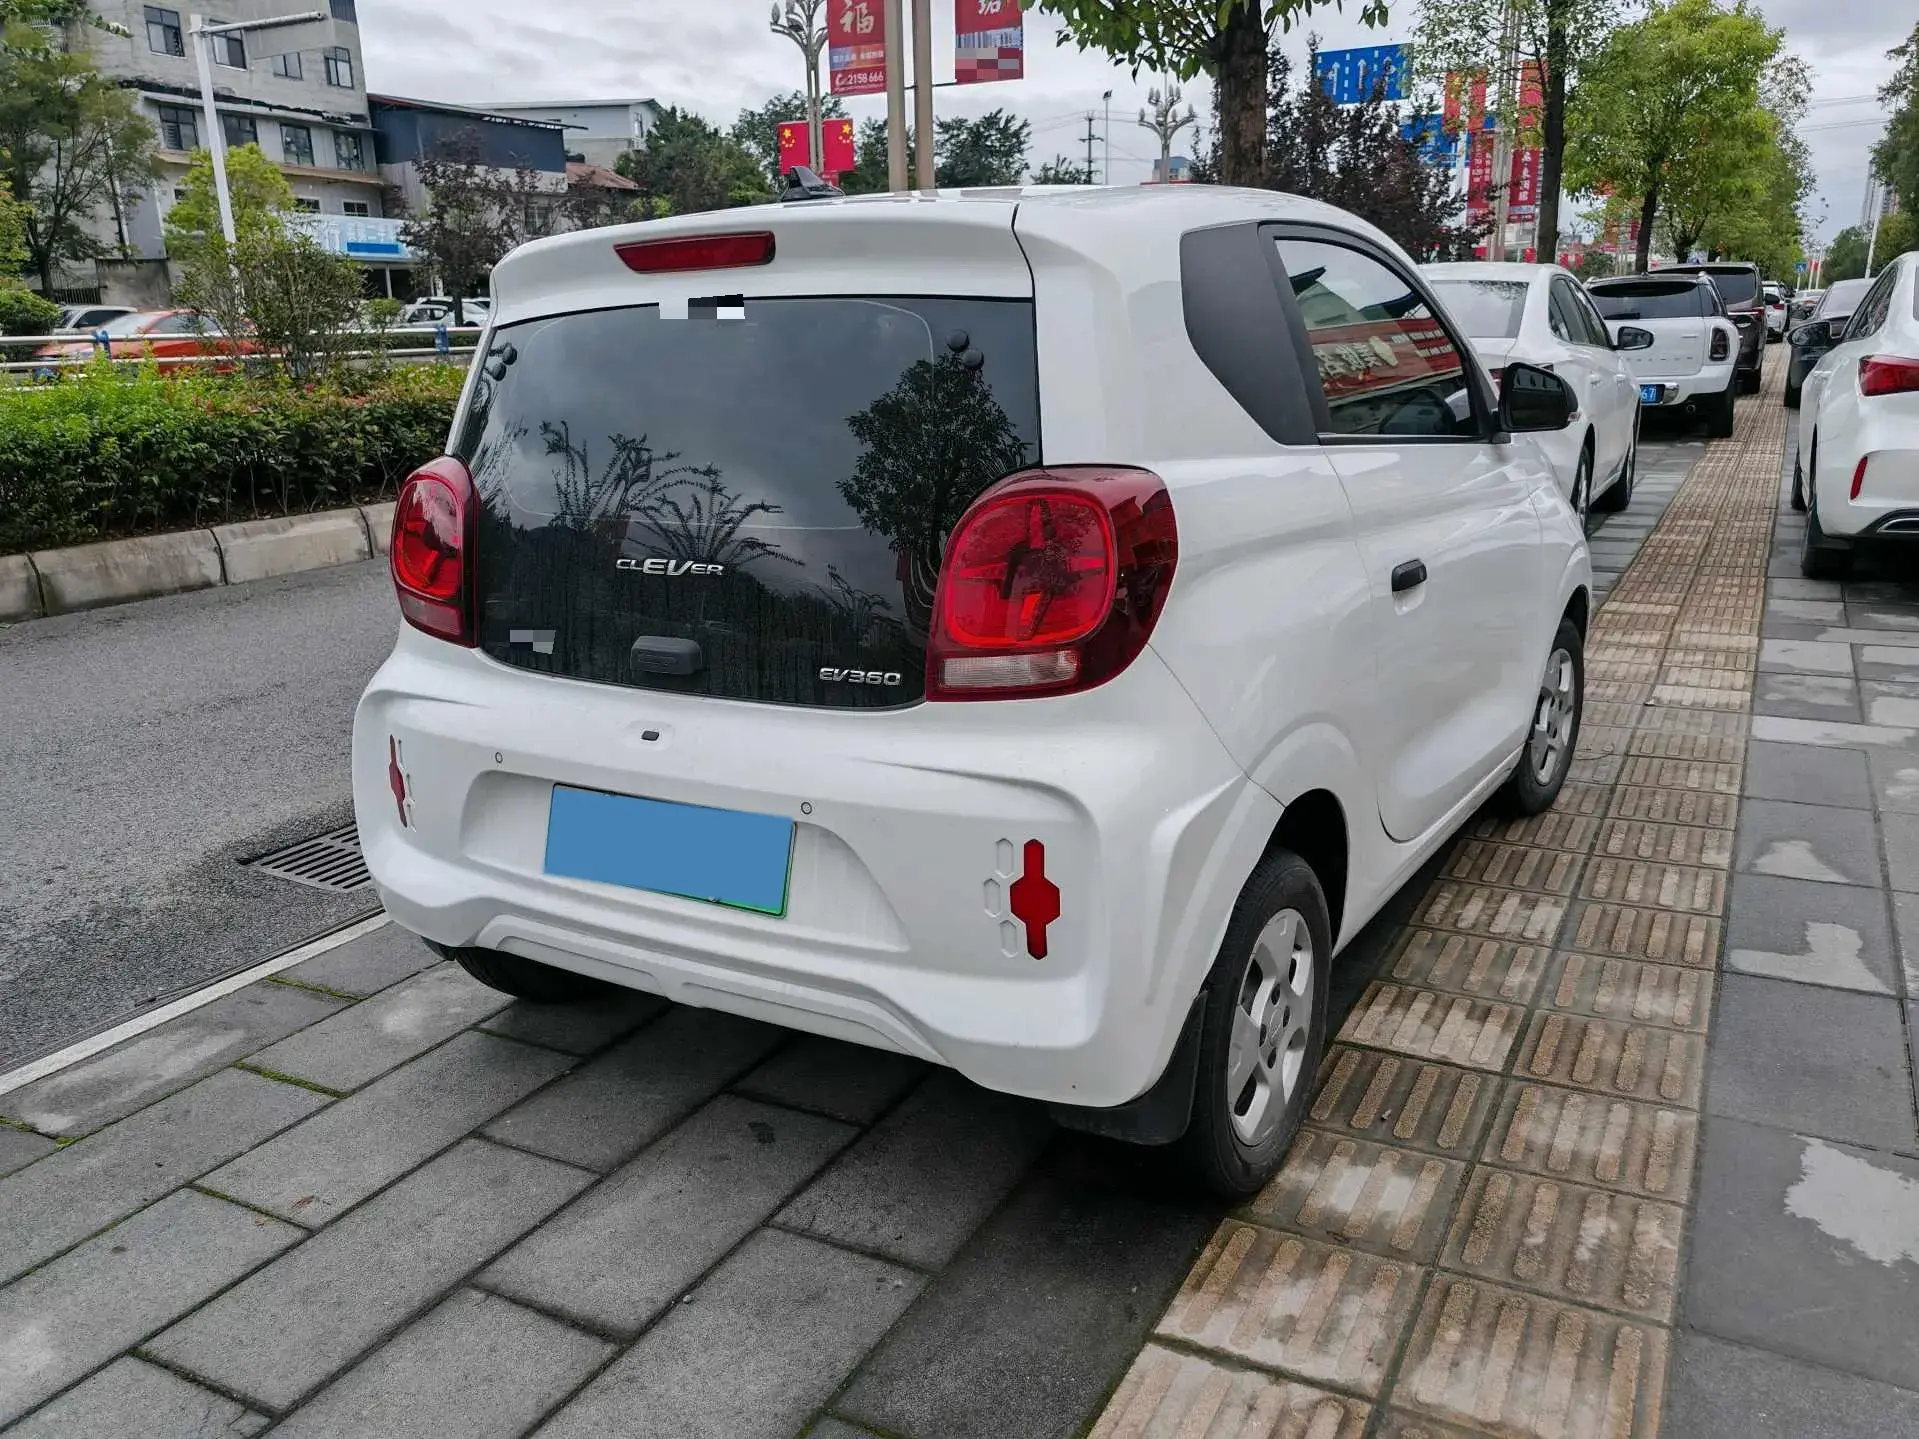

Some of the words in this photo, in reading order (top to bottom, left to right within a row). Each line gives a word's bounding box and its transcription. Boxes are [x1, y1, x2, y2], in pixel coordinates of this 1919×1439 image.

[839, 0, 875, 34] 福
[615, 558, 724, 576] CLEVER
[819, 667, 901, 686] EV360
